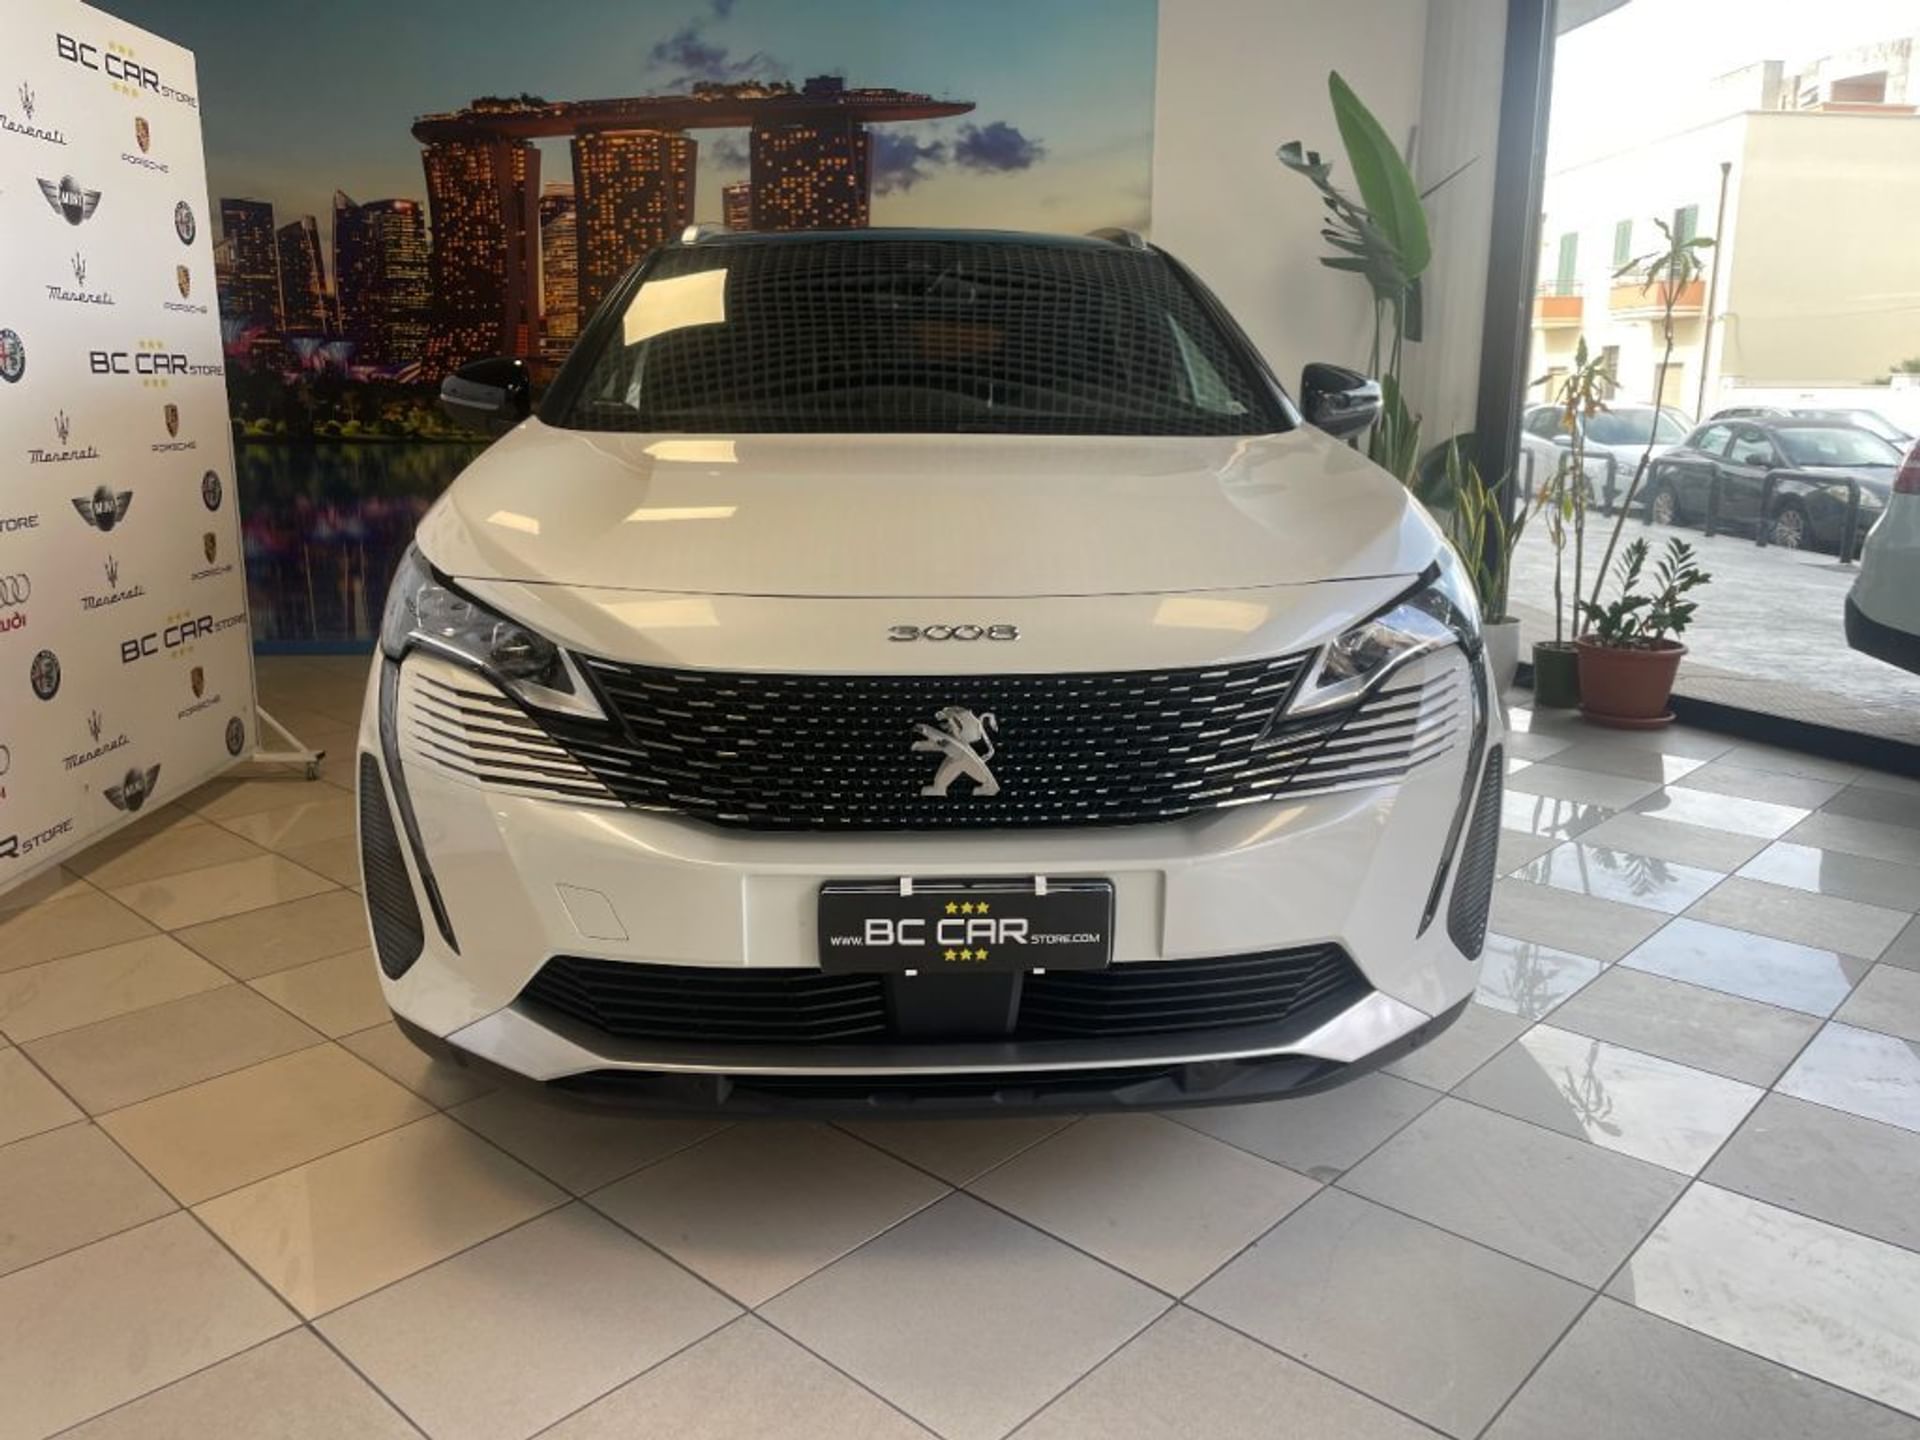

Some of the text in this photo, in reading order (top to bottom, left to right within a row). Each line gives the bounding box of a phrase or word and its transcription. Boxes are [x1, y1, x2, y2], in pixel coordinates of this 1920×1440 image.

[56, 32, 198, 108] BC CAR STORE
[121, 152, 170, 174] PORSCHE
[46, 285, 115, 306] Maserati
[163, 301, 208, 315] PORSCHE
[90, 351, 225, 377] BC CAR STORE
[27, 446, 100, 464] Maserati
[0, 514, 39, 531] TORE
[0, 611, 27, 632] udi
[120, 612, 247, 664] BC CAR STORE
[887, 624, 1021, 642] 3008
[22, 817, 74, 855] STORE
[864, 918, 926, 946] BC
[936, 918, 1029, 945] CAR
